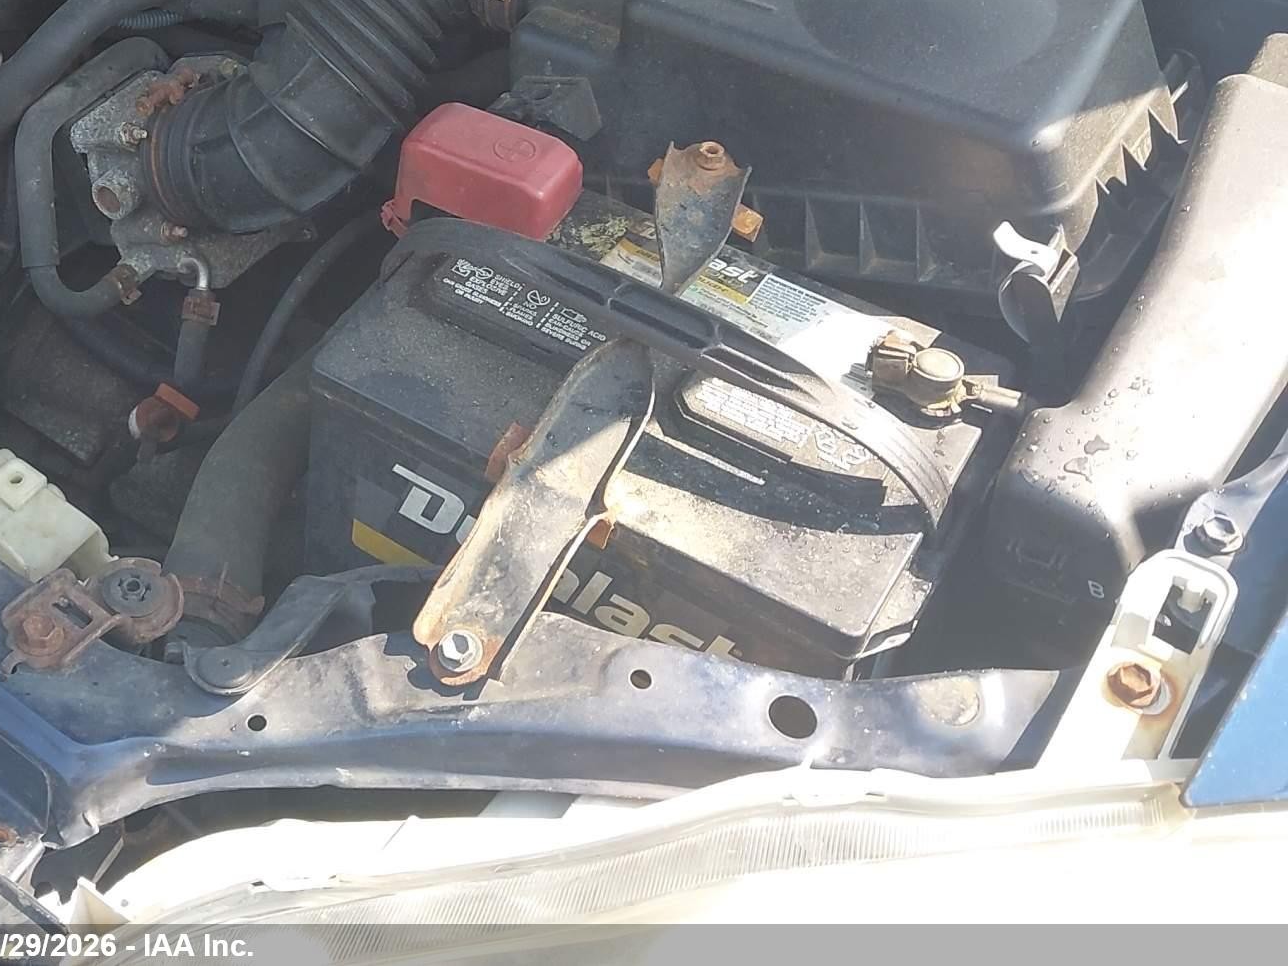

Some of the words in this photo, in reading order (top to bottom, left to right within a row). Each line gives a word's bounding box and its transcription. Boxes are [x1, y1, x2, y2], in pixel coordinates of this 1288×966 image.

[465, 281, 489, 295] GASES
[469, 276, 508, 296] EXPLOSIVE
[489, 278, 509, 291] EYES
[494, 274, 520, 288] SHIELD
[523, 301, 537, 310] NO
[544, 322, 580, 341] BLINDNESS
[580, 337, 592, 347] OR
[552, 313, 588, 333] SULFURIC
[587, 330, 607, 342] ACID
